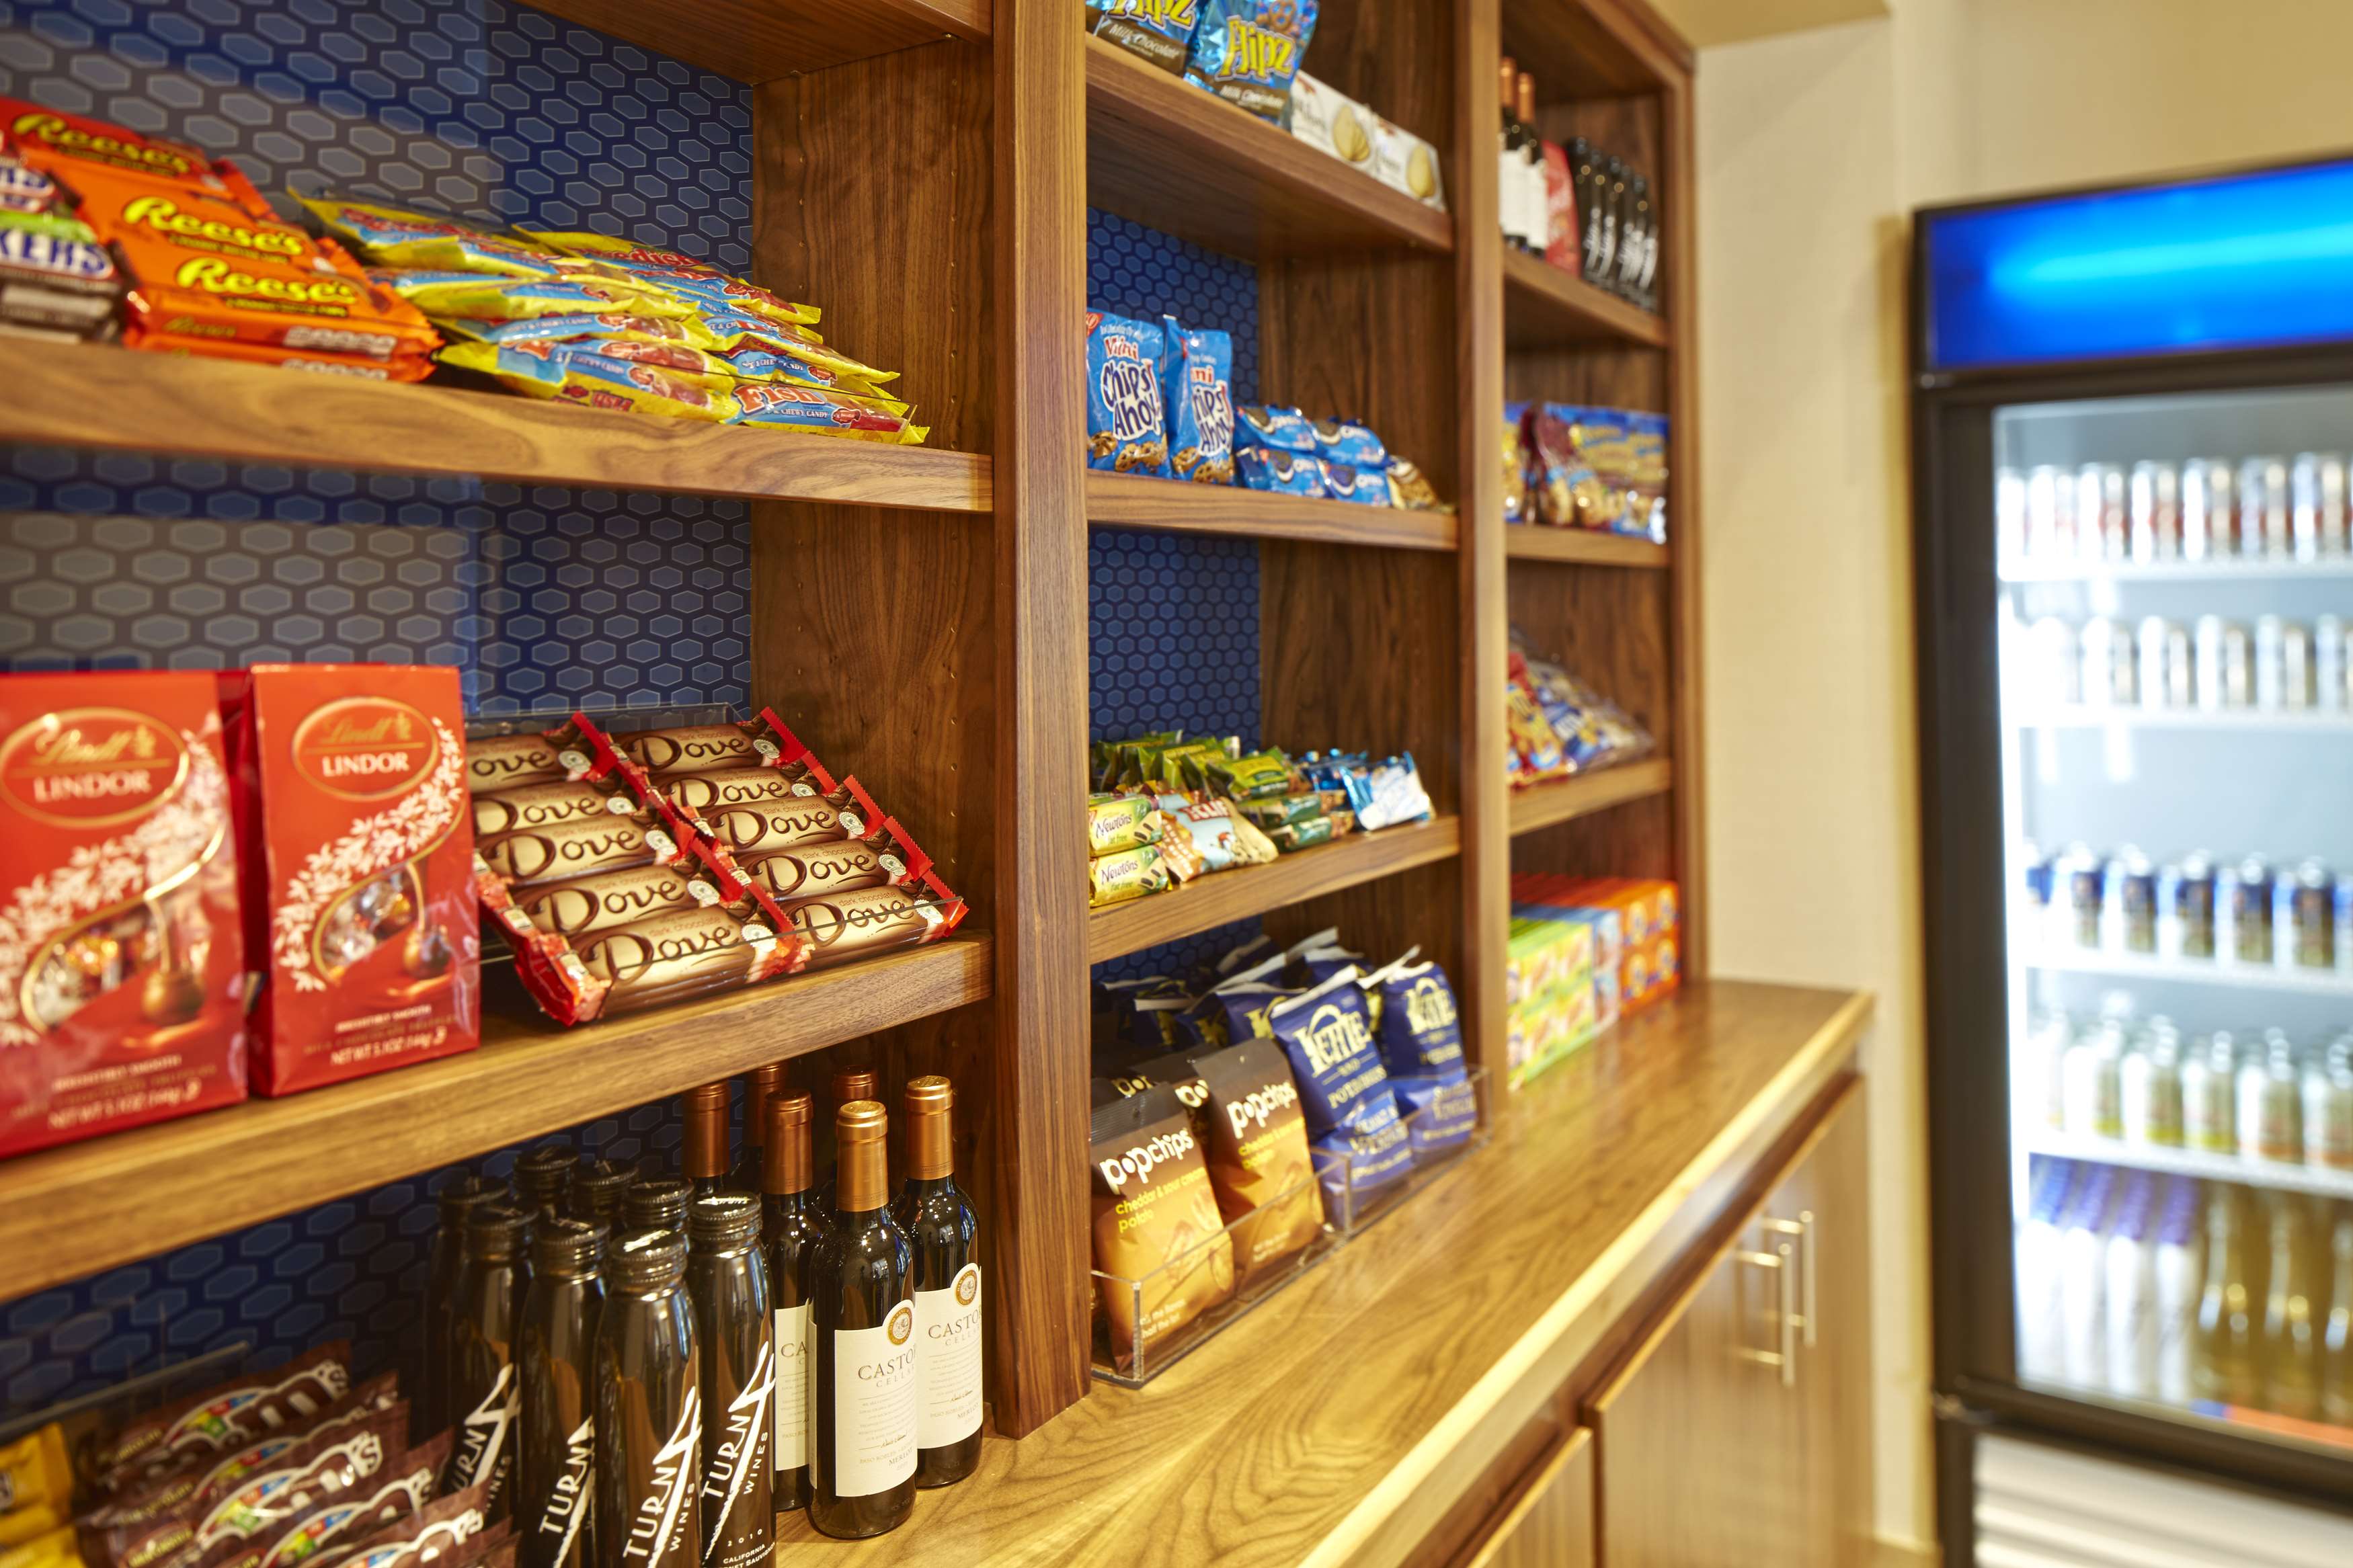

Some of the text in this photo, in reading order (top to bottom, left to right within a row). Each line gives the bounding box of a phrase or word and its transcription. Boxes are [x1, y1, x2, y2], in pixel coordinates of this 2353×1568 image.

[13, 112, 190, 174] Reese's
[123, 196, 303, 256] Reese's
[176, 257, 357, 305] Reese's
[733, 384, 826, 414] Fish
[1102, 361, 1152, 408] Chips
[805, 409, 830, 419] CANDY
[321, 751, 410, 778] LINDOR
[472, 751, 555, 776] ove
[625, 735, 752, 771] Dove
[33, 769, 152, 803] LINDOR
[656, 778, 791, 808] Dove
[471, 796, 604, 836] Dove
[707, 808, 836, 850] Dove
[763, 802, 822, 815] dark chocolate
[480, 830, 643, 880] Dove
[801, 845, 862, 860] dark chocolate
[745, 854, 878, 897] Dove
[526, 880, 686, 937] Dove
[838, 891, 898, 907] dark chocolate
[649, 915, 721, 938] dark chocolate
[784, 900, 915, 948] Dove
[577, 925, 741, 985] Dove
[1226, 1081, 1298, 1139] popchips
[1099, 1129, 1194, 1196] popchips
[1115, 1189, 1157, 1215] cheddar
[1156, 1185, 1164, 1198] &
[1162, 1180, 1181, 1195] sour
[701, 1414, 752, 1499] TURN
[742, 1431, 768, 1495] WINES
[538, 1446, 592, 1534] TURN
[623, 1466, 678, 1559] TURN
[668, 1482, 696, 1553] WINES
[722, 1542, 766, 1565] CALIFORNIA
[727, 1528, 764, 1548] 2010
